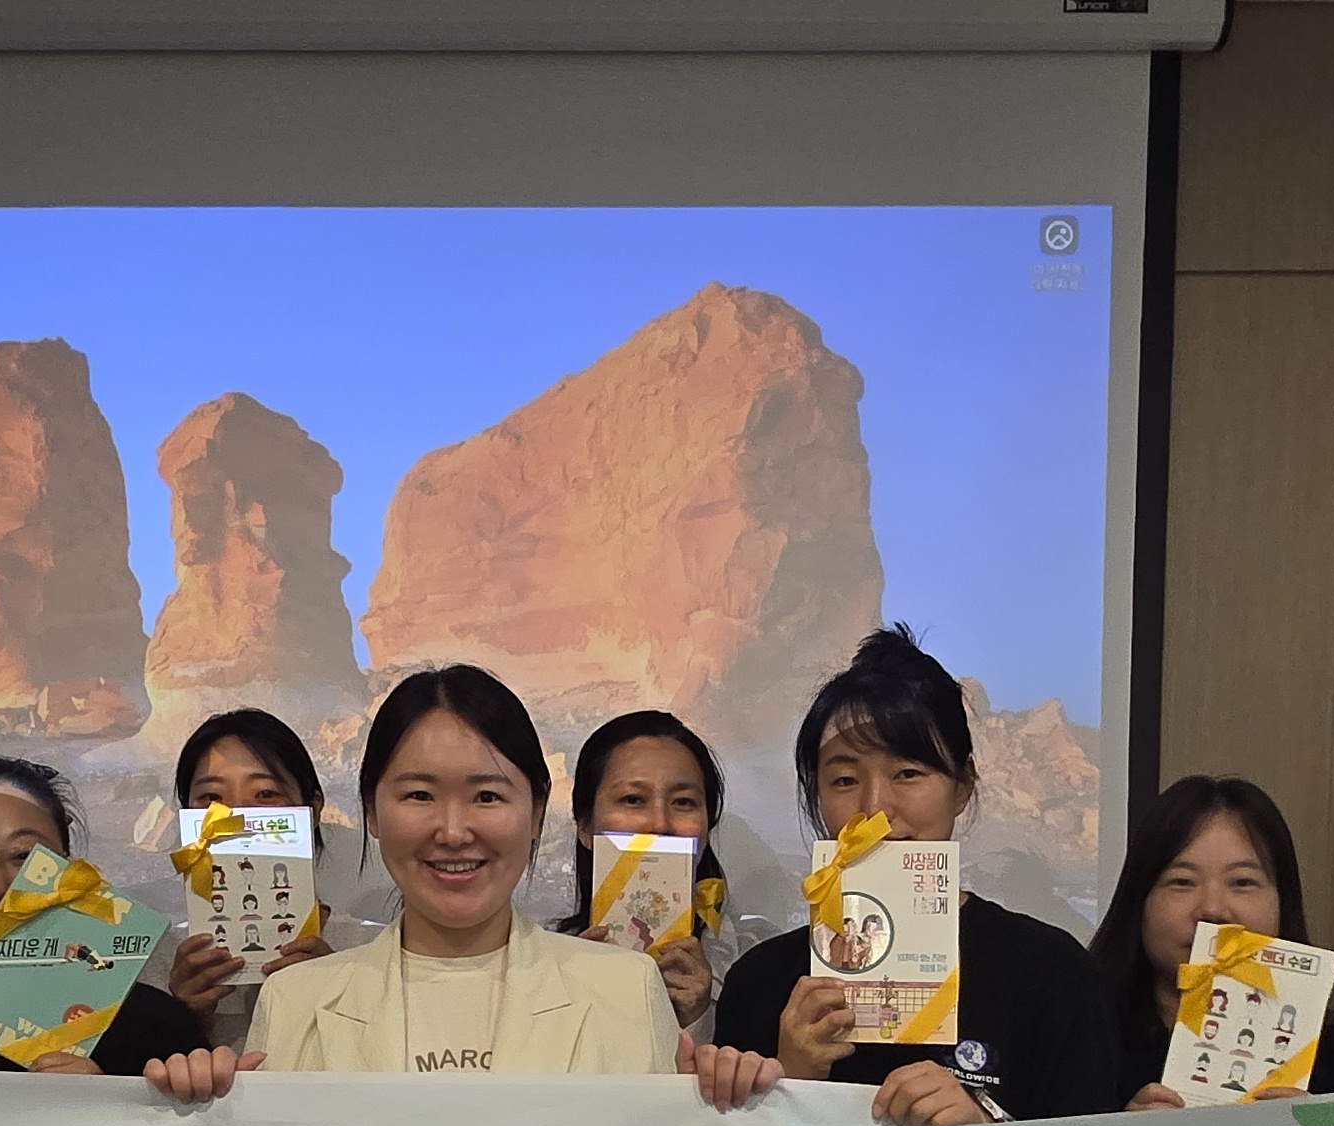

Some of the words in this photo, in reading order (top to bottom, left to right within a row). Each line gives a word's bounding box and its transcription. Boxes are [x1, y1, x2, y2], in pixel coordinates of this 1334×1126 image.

[266, 817, 290, 831] 수업
[901, 852, 948, 871] 화장품이
[43, 936, 60, 957] 게
[112, 935, 152, 955] 뭔데?
[1287, 954, 1313, 971] 수업
[943, 1066, 1001, 1085] ORLDWIDE
